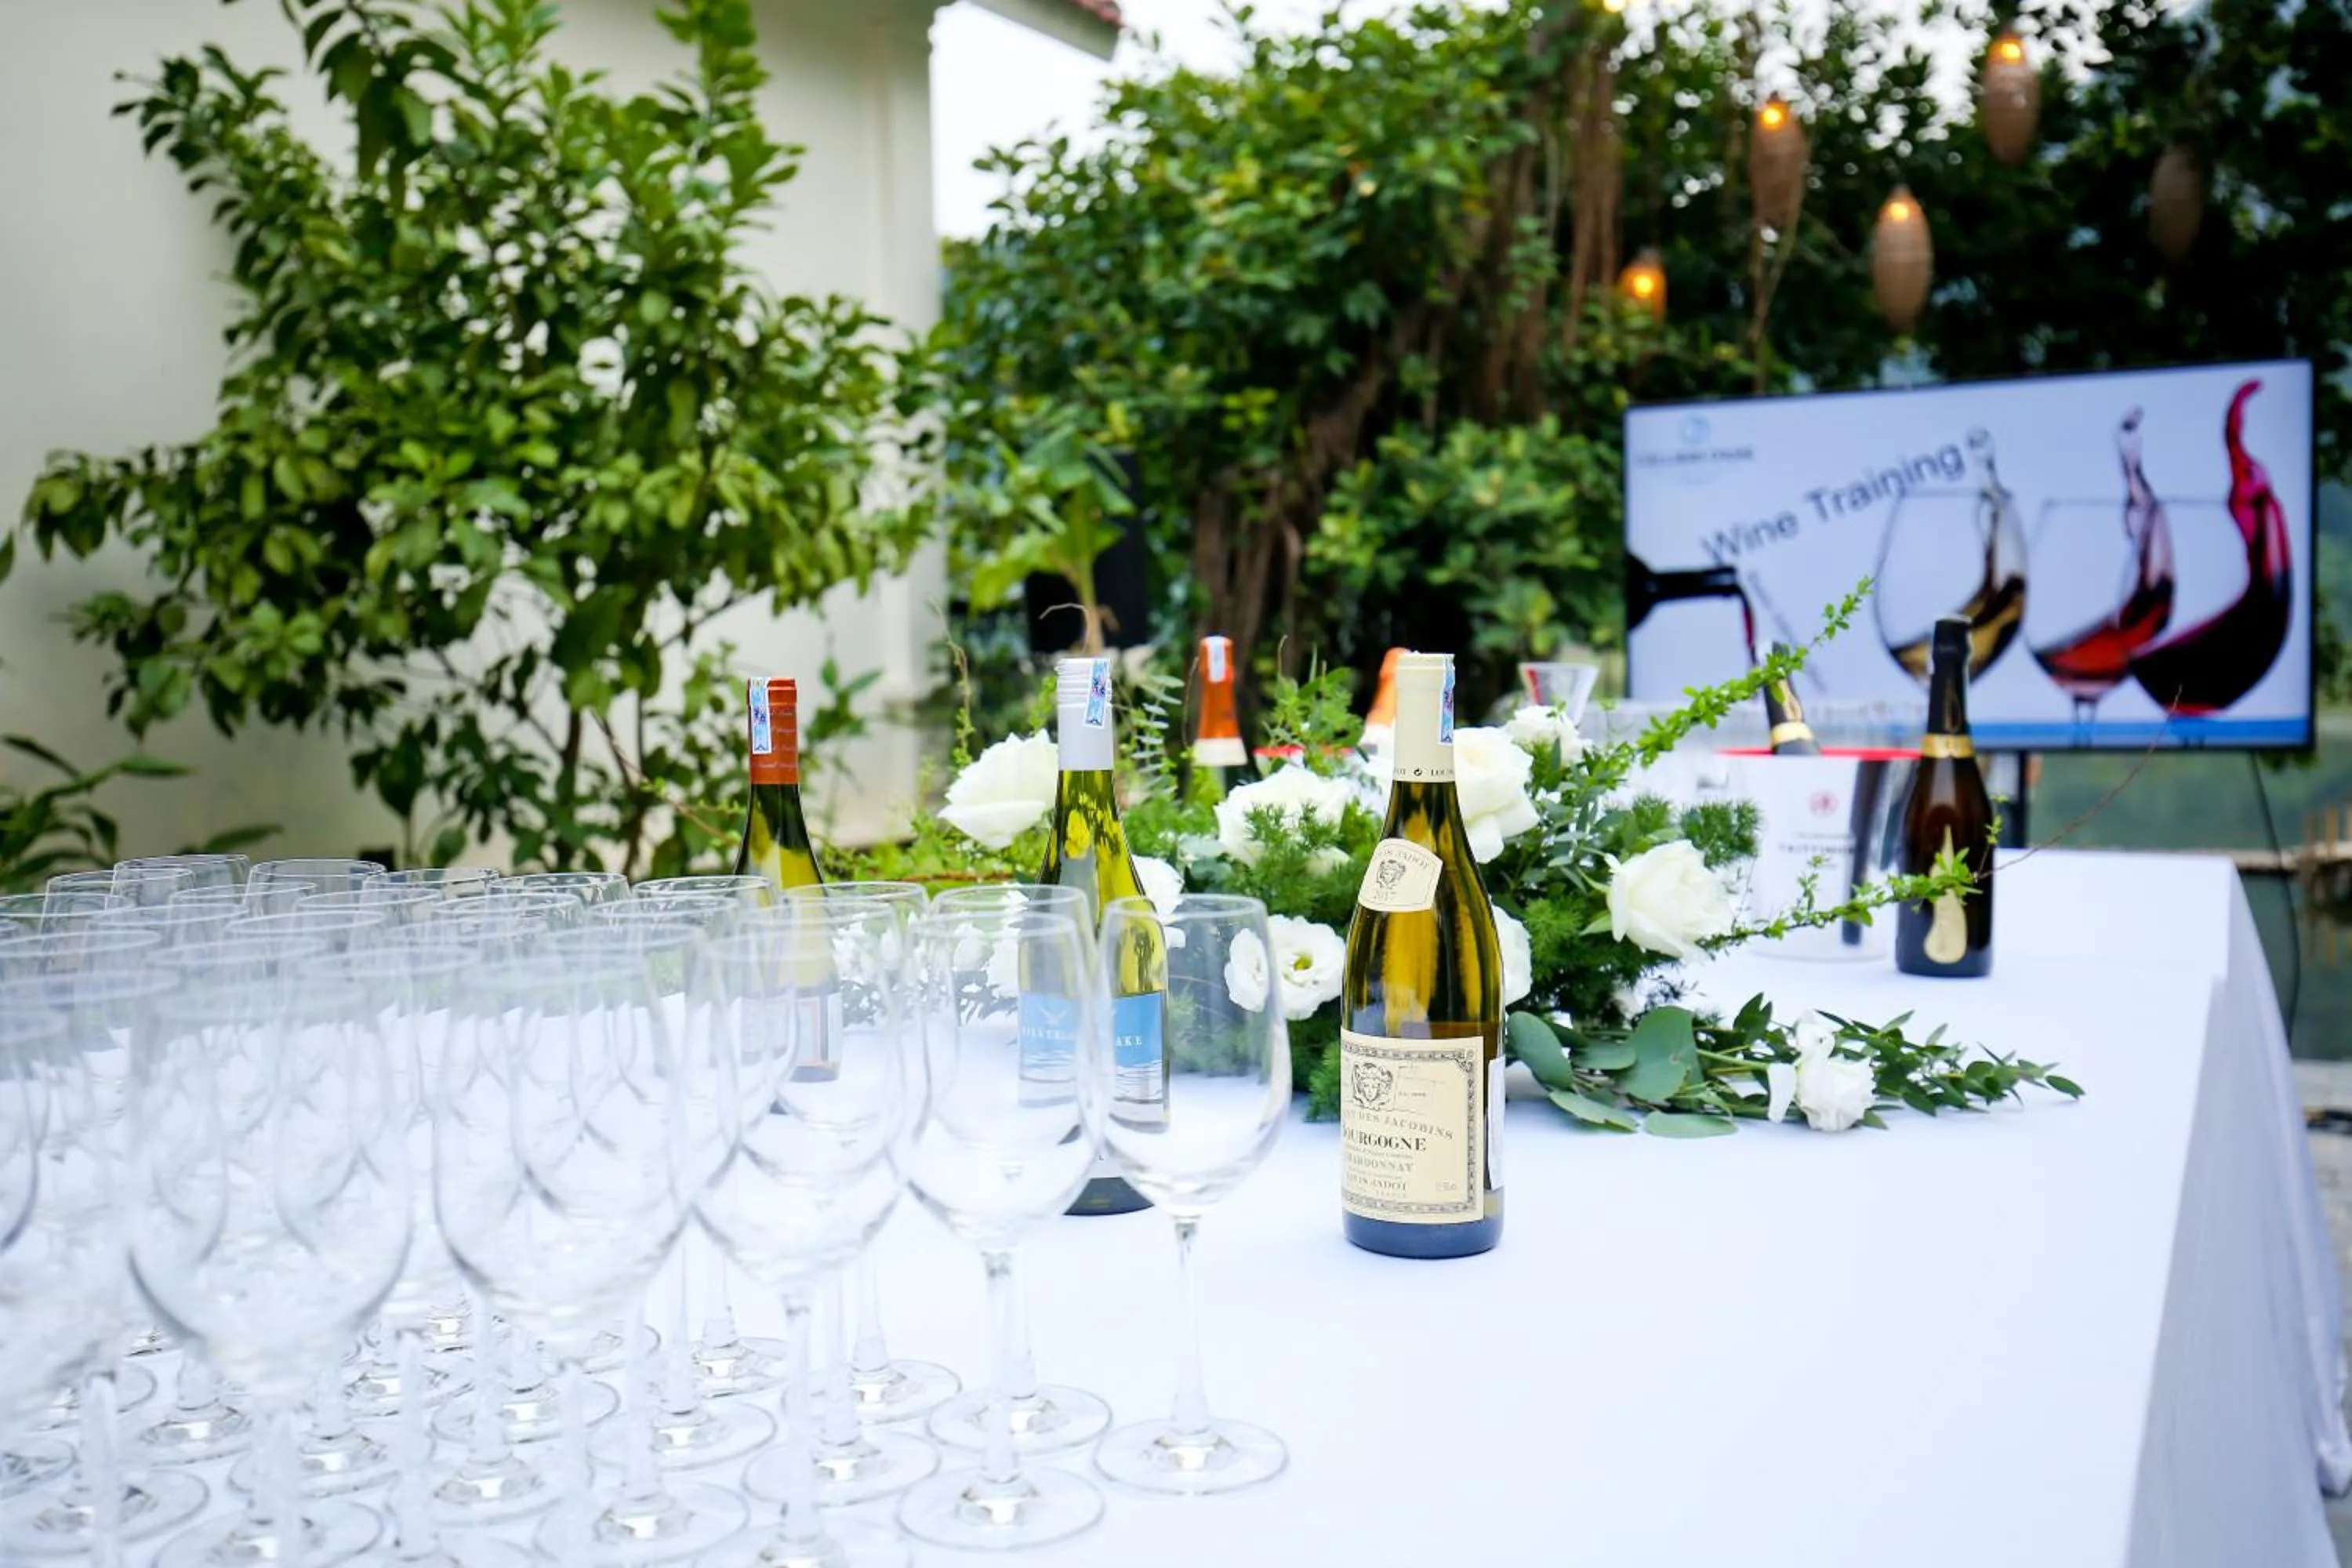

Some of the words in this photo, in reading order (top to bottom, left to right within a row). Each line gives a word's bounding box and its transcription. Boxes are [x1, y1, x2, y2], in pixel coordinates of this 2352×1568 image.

[1700, 511, 1799, 564] Wine
[1803, 444, 1965, 522] Training
[1385, 1116, 1454, 1140] JACOBINS
